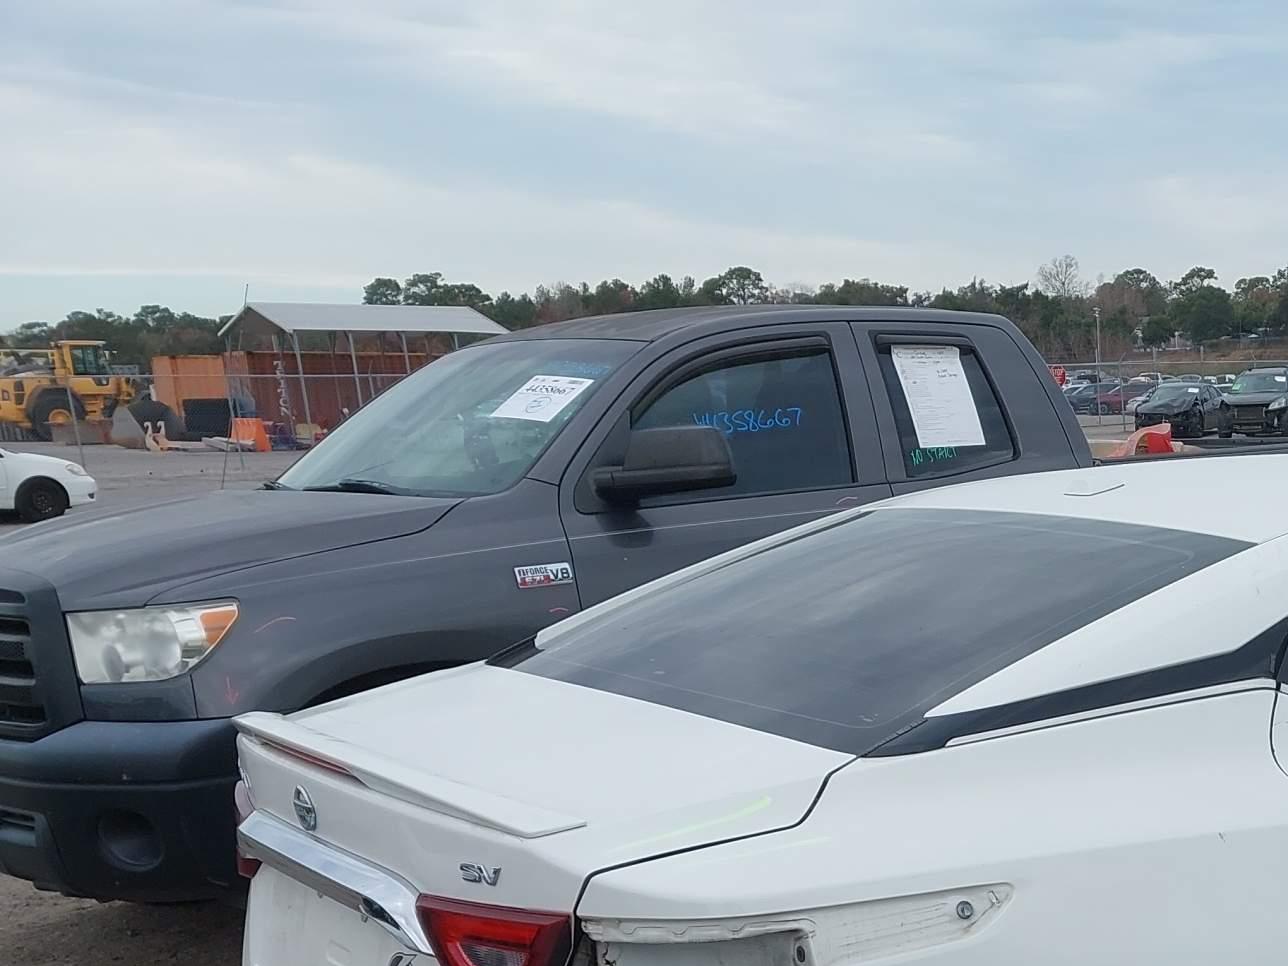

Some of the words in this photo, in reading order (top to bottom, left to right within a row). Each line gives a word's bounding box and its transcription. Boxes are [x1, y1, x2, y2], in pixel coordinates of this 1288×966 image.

[693, 408, 801, 434] 44358667
[550, 567, 571, 580] V8
[460, 862, 501, 887] SV
